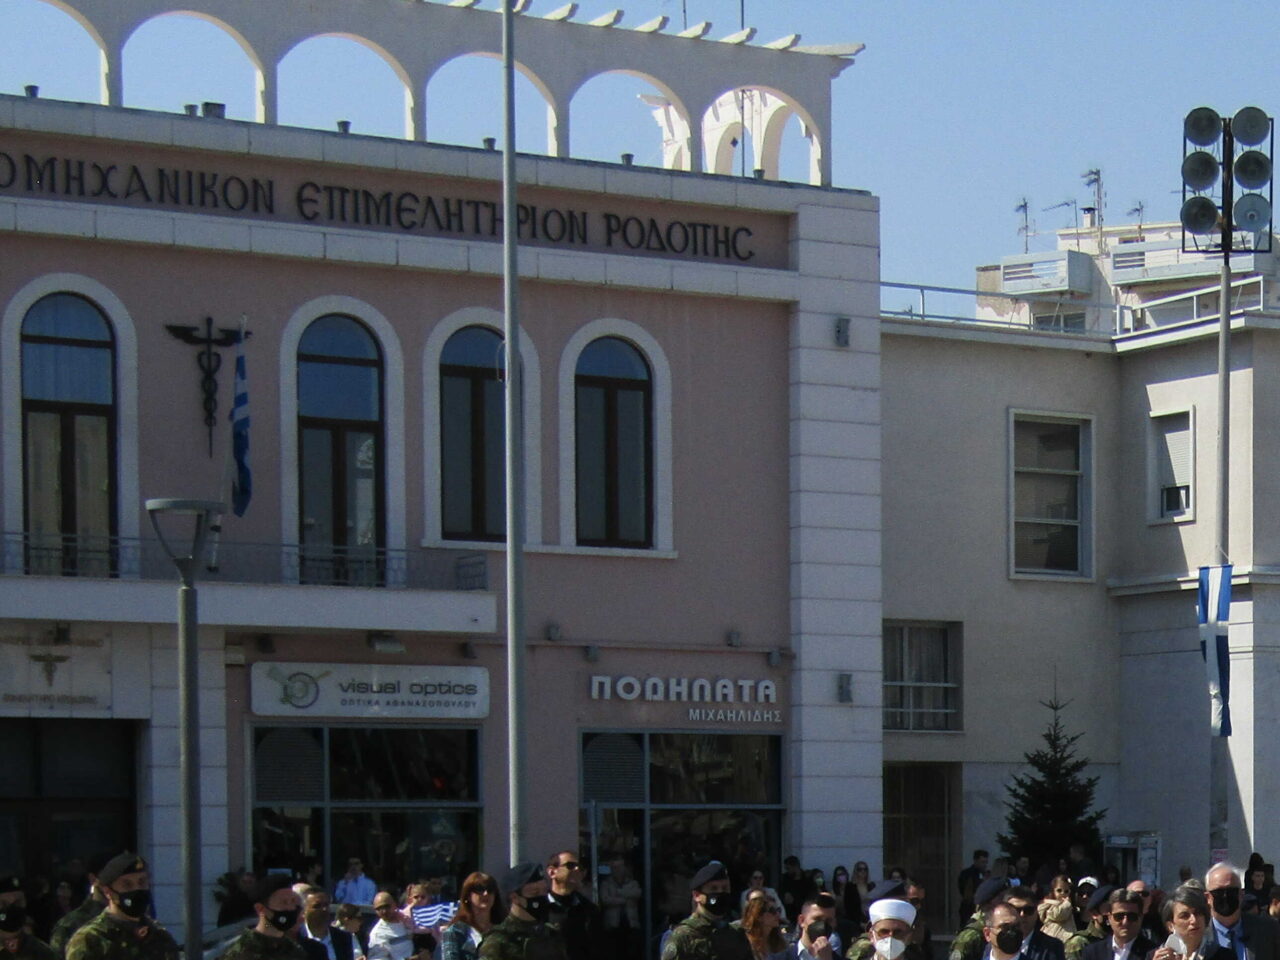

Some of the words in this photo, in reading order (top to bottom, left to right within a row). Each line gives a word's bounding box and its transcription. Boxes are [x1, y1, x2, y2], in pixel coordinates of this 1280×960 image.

[338, 679, 401, 695] visual
[409, 679, 479, 698] optics
[689, 708, 783, 722] ΜΙΧΑΗΛΙΔΗΣ
